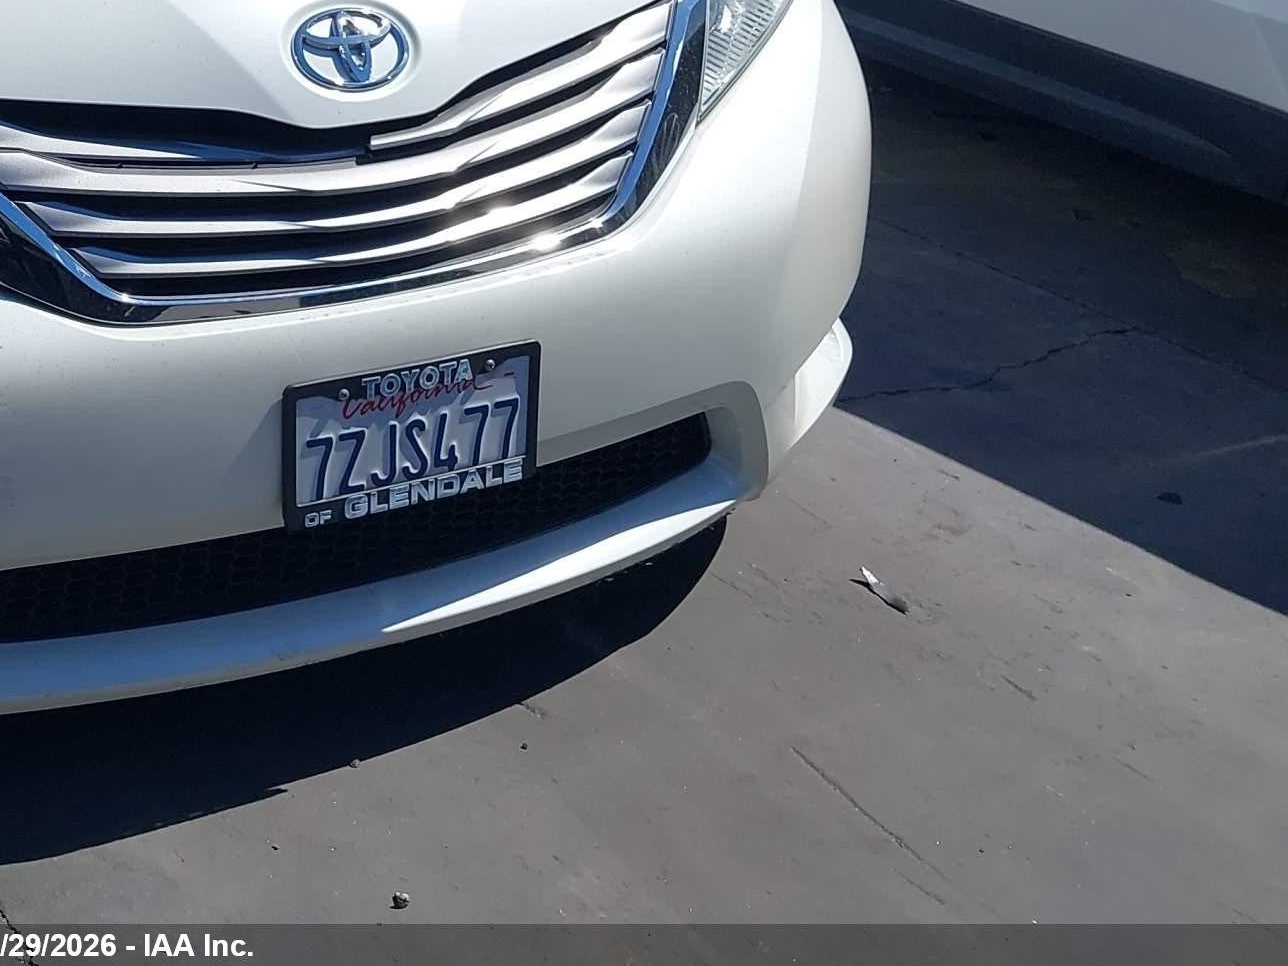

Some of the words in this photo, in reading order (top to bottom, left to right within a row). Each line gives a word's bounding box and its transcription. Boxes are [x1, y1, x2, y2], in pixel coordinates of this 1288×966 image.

[362, 359, 474, 400] TOYOTA
[305, 396, 521, 502] 7ZJS477
[304, 509, 333, 528] OF
[344, 459, 523, 520] GLENDALE
